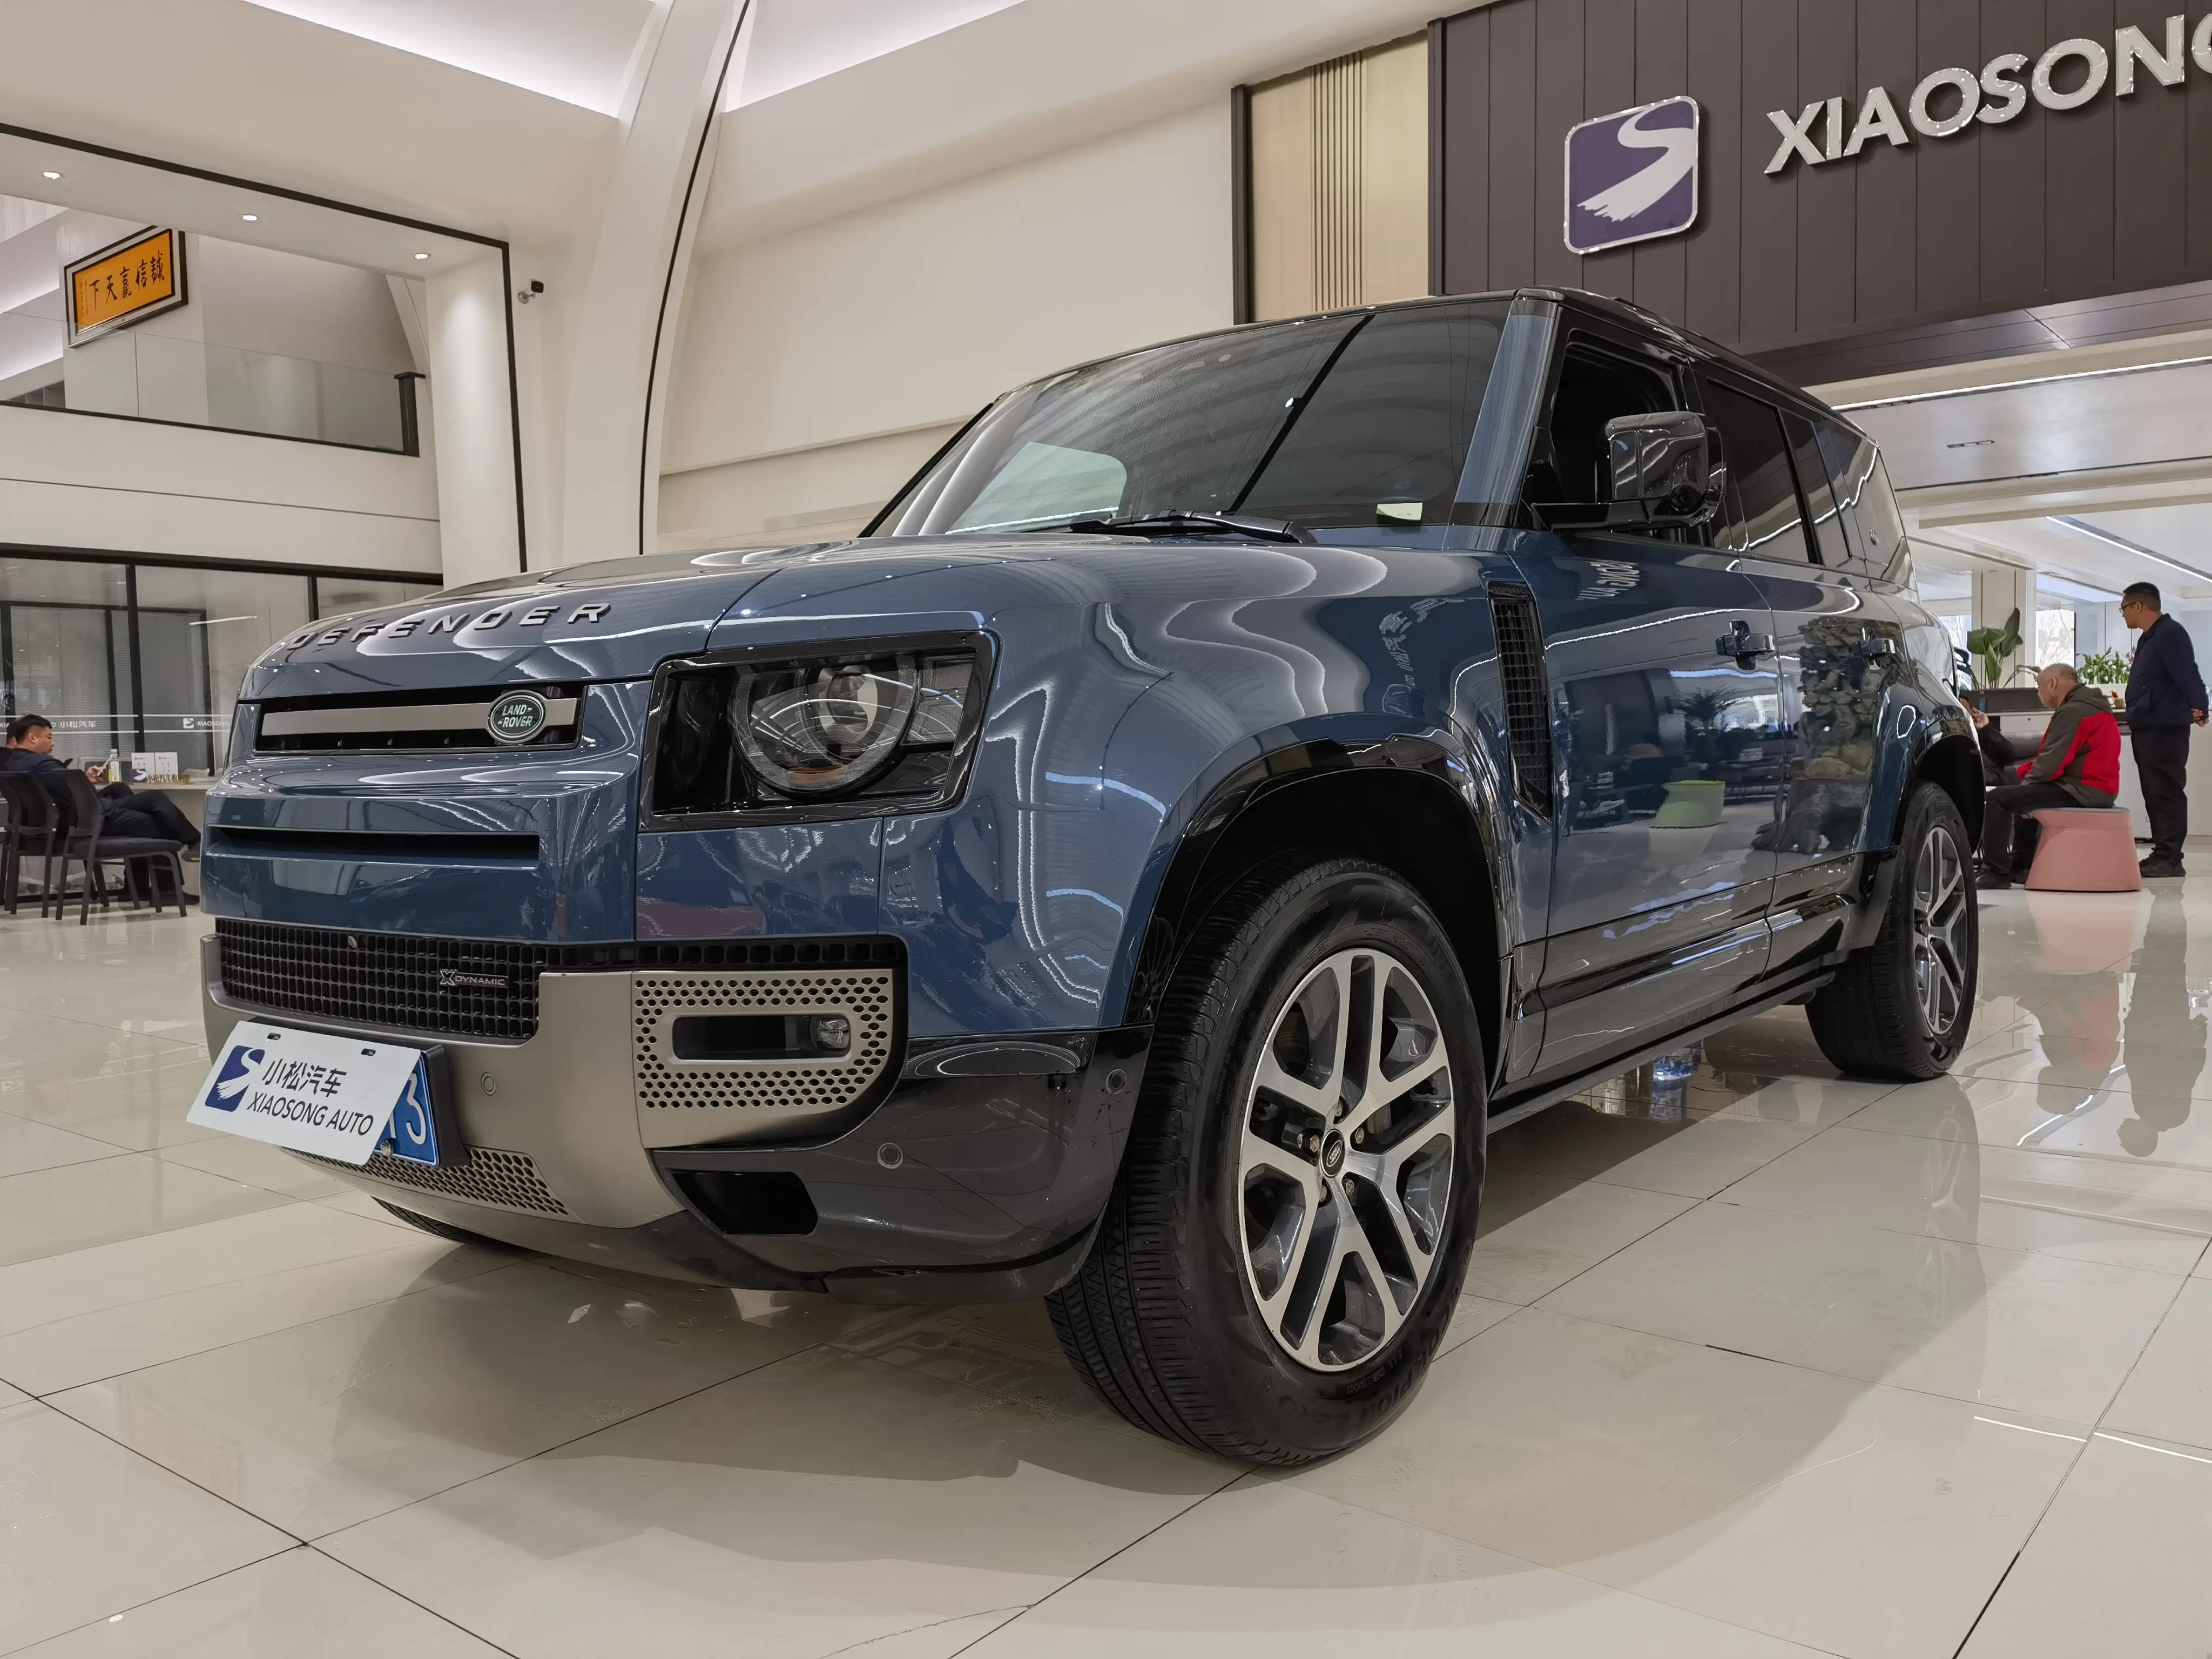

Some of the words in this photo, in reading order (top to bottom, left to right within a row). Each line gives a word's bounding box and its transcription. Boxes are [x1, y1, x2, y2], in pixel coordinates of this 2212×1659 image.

[286, 602, 611, 650] DEFENDER
[501, 704, 527, 716] LAND
[502, 716, 533, 728] ROVER
[455, 975, 505, 986] DYNAMIC
[261, 1058, 347, 1097] 小松汽车
[246, 1091, 328, 1126] XIAOSONG
[326, 1109, 374, 1136] AUTO
